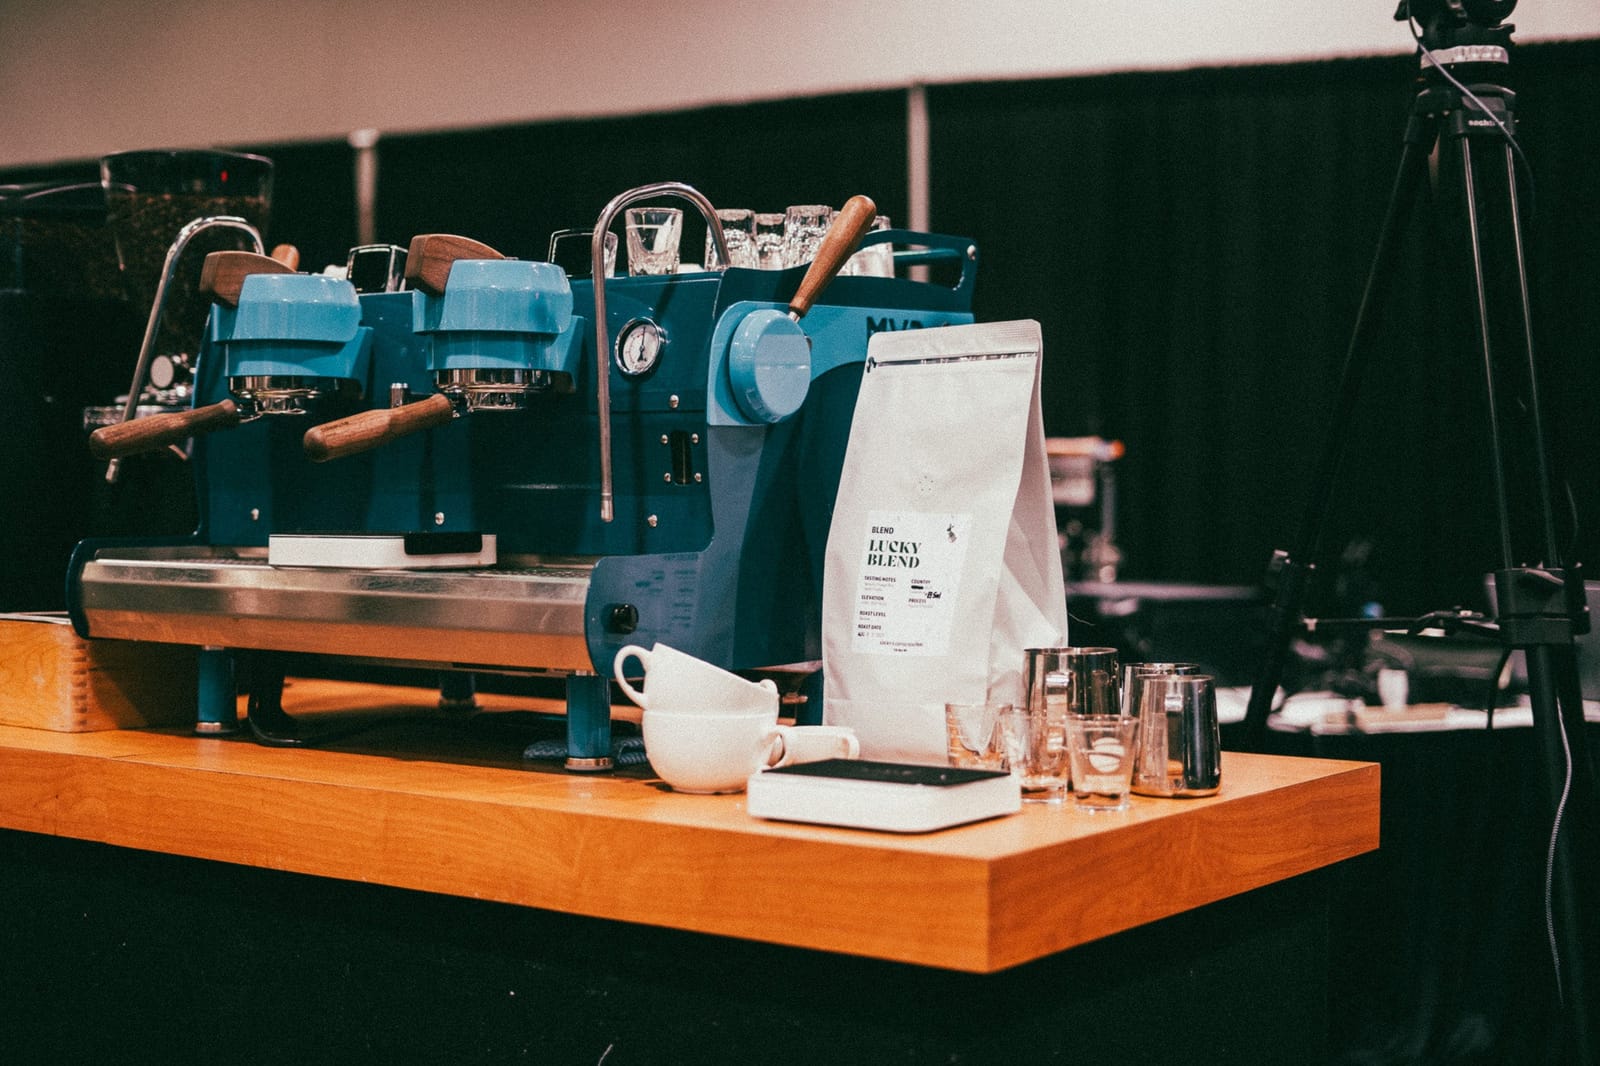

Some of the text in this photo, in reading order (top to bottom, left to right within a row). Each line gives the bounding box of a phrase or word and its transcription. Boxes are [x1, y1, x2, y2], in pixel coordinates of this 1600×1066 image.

[1468, 119, 1505, 127] sachtr
[871, 526, 894, 535] BLEND
[869, 539, 922, 554] LUCKY
[867, 553, 920, 569] BLEND
